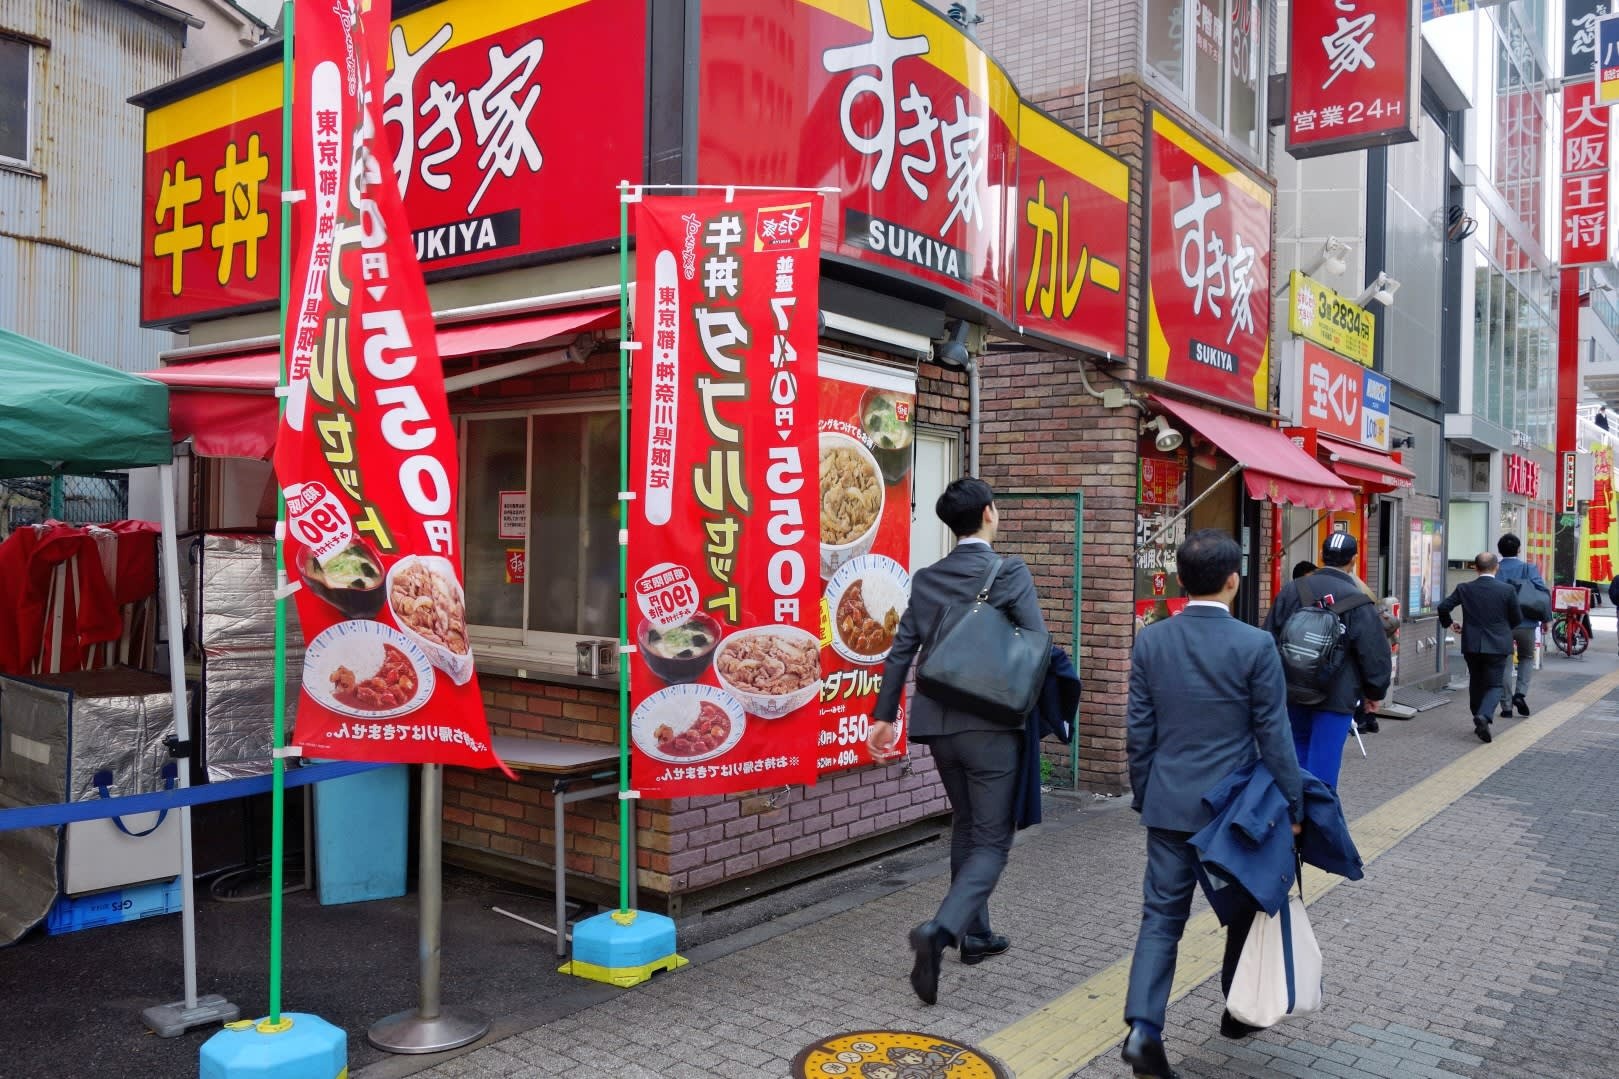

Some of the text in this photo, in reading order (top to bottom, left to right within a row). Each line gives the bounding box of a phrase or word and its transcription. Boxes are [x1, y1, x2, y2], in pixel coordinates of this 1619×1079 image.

[1321, 0, 1376, 90] 家
[384, 23, 544, 215] すき家
[823, 0, 984, 238] すき家
[1293, 98, 1401, 133] 営業24H
[1565, 95, 1607, 249] 大阪王将
[154, 133, 269, 296] 牛丼
[411, 217, 497, 262] UKIYA
[868, 219, 960, 279] SUKIYA
[1025, 177, 1121, 320] カレー
[1174, 164, 1255, 345] すき家
[1195, 342, 1234, 373] SUKIYA
[1309, 362, 1358, 426] 宝くじ
[510, 552, 525, 573] すき
[819, 669, 882, 703] ダブルセ
